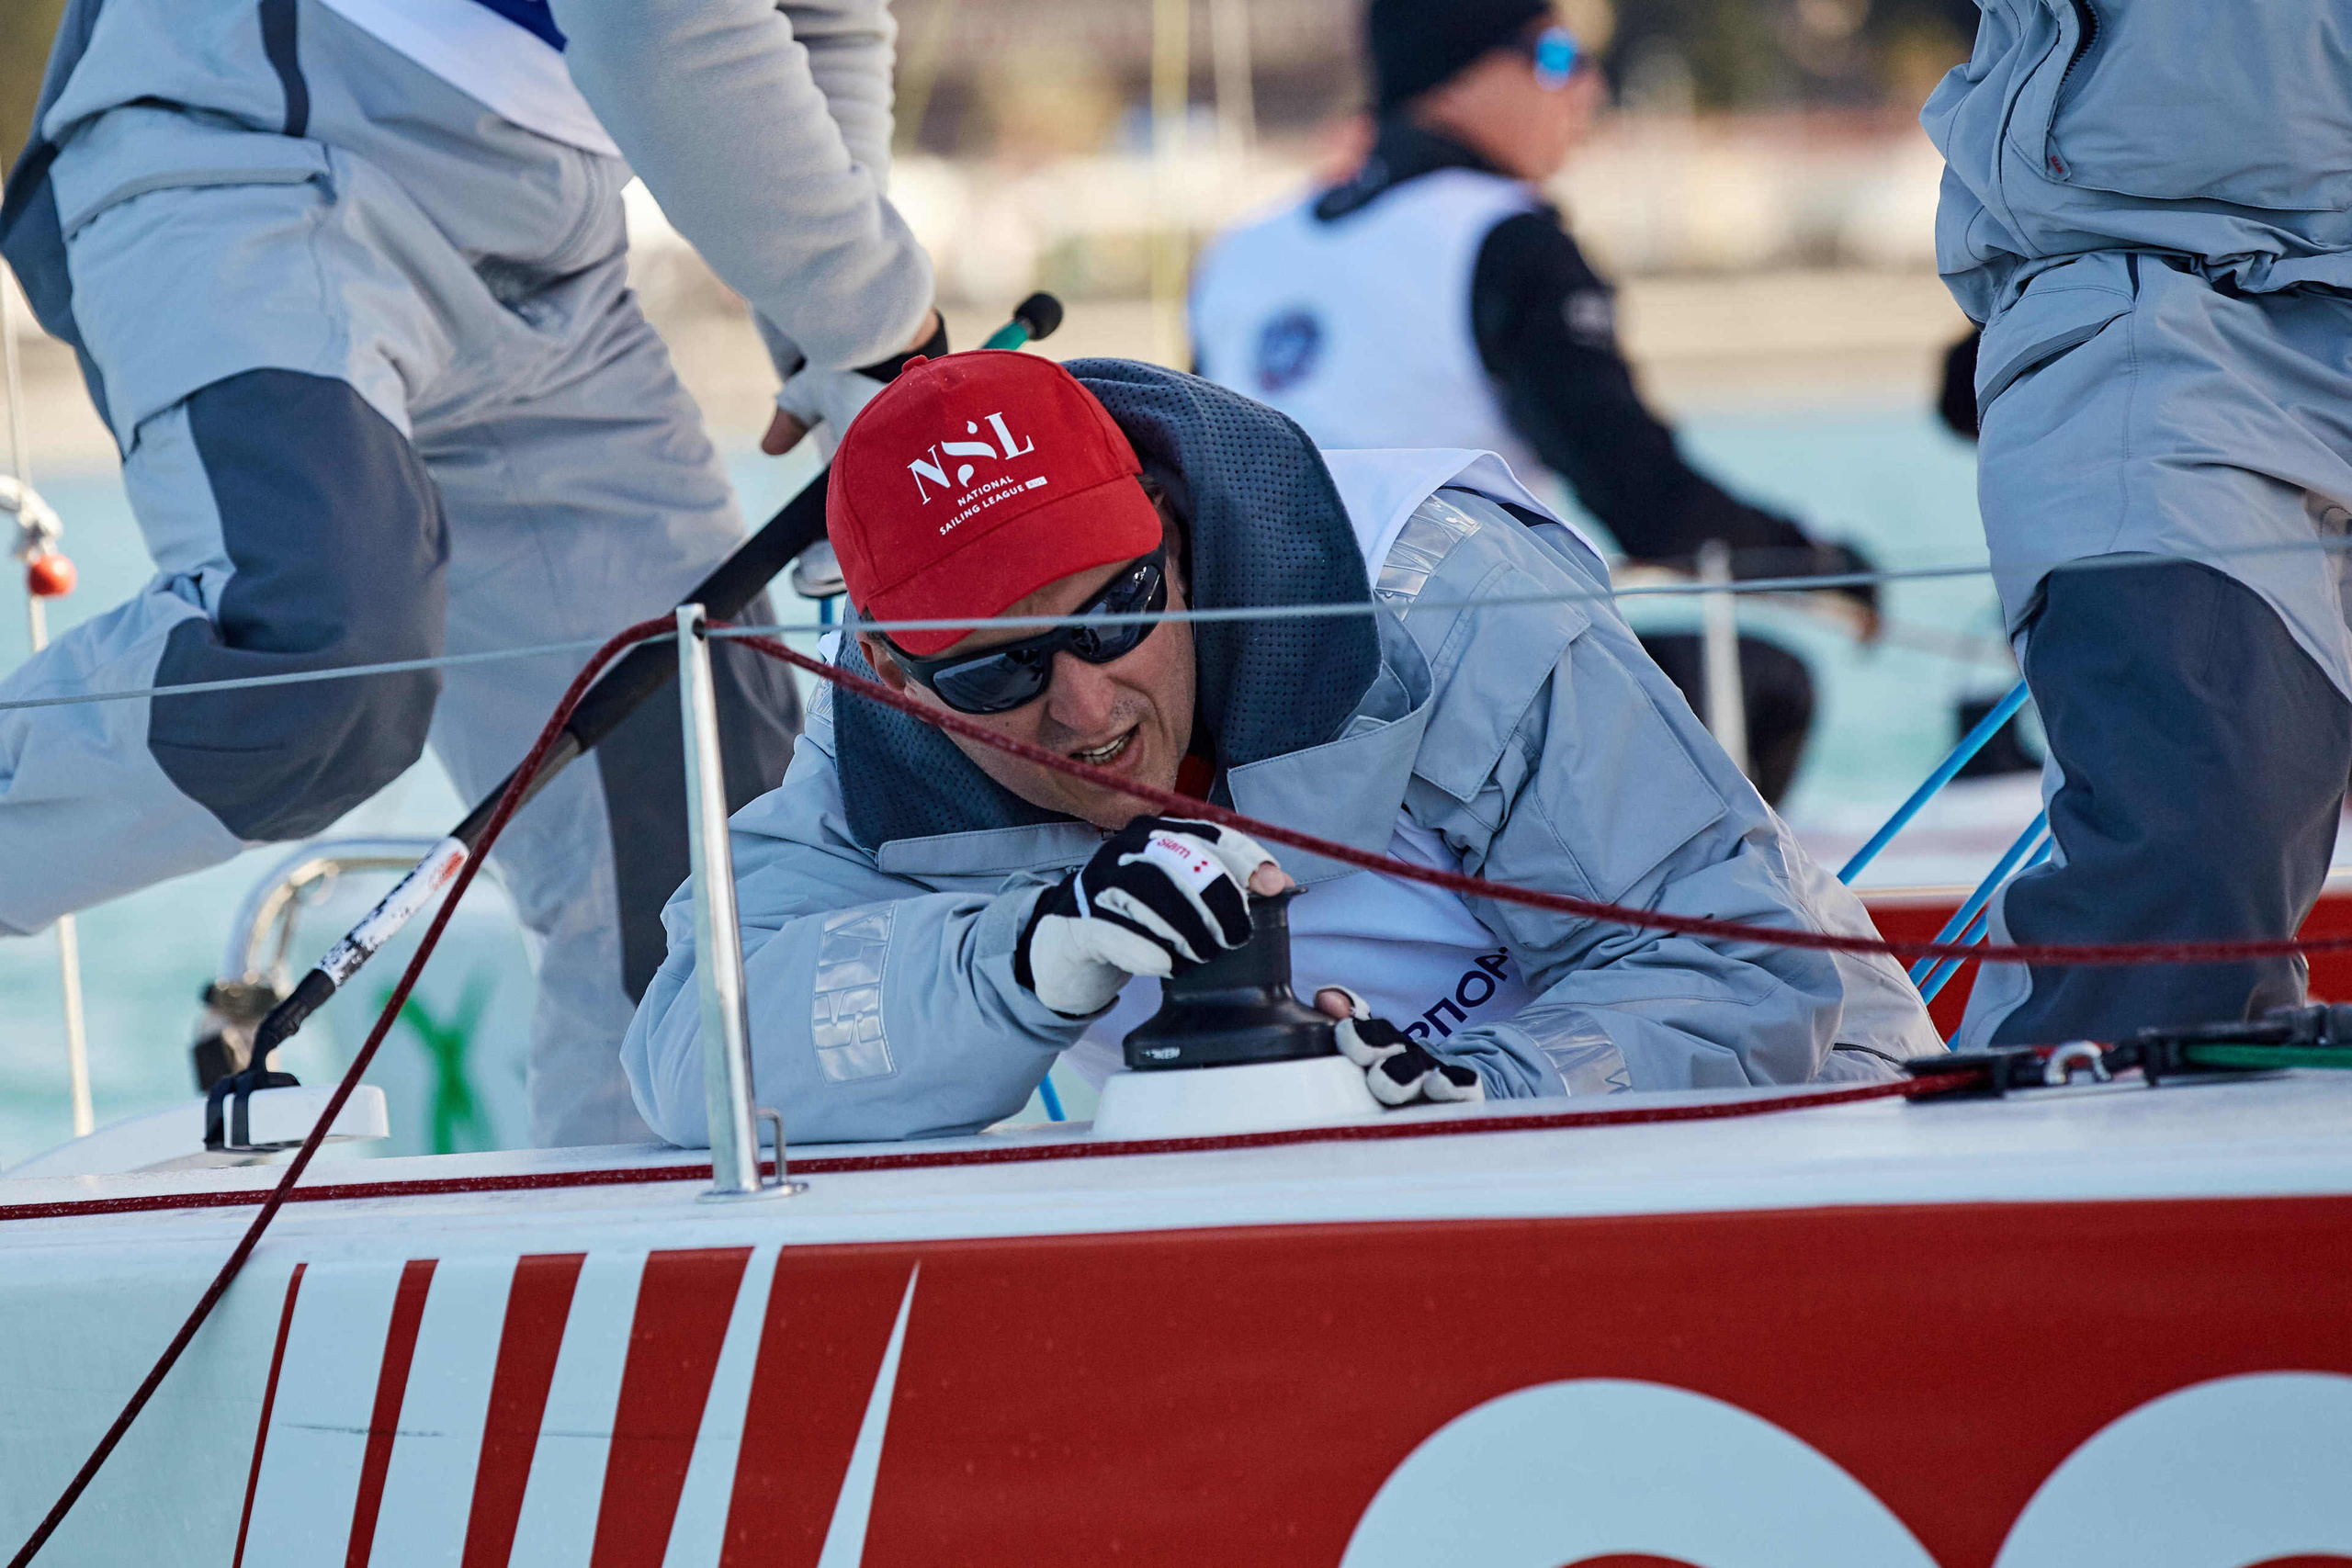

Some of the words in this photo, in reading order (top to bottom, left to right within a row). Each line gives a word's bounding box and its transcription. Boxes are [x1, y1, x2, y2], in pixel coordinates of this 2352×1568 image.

[907, 412, 1035, 505] NSL
[939, 504, 981, 536] SAILING
[981, 484, 1025, 509] LEAGUE
[957, 475, 1013, 507] NATIONAL
